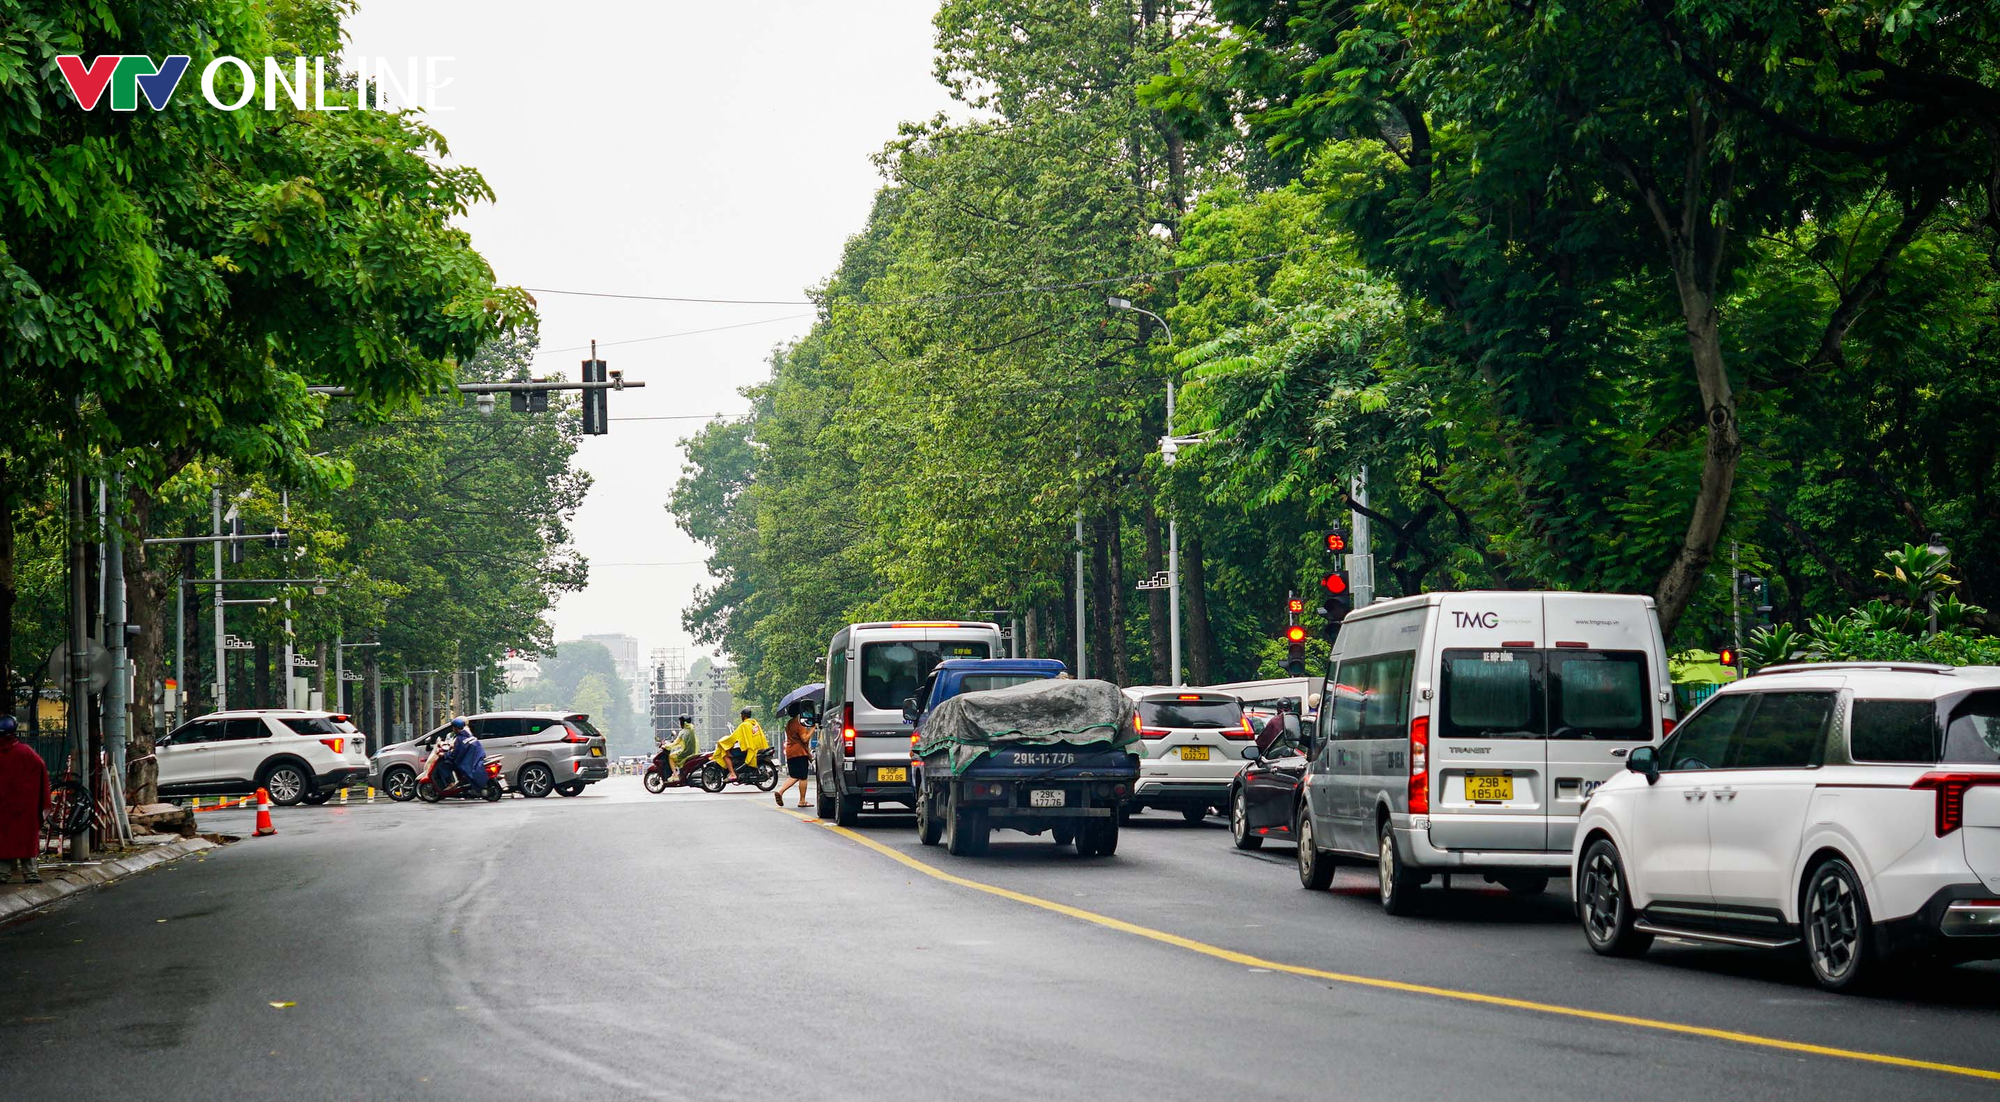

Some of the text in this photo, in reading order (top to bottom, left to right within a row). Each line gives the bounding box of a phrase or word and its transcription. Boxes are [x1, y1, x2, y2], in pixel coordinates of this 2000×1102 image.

[1452, 610, 1499, 628] TMG
[1449, 746, 1492, 754] TRANSIT
[1479, 778, 1499, 787] 29B
[1040, 790, 1055, 798] 29K
[1472, 789, 1508, 799] 185.04
